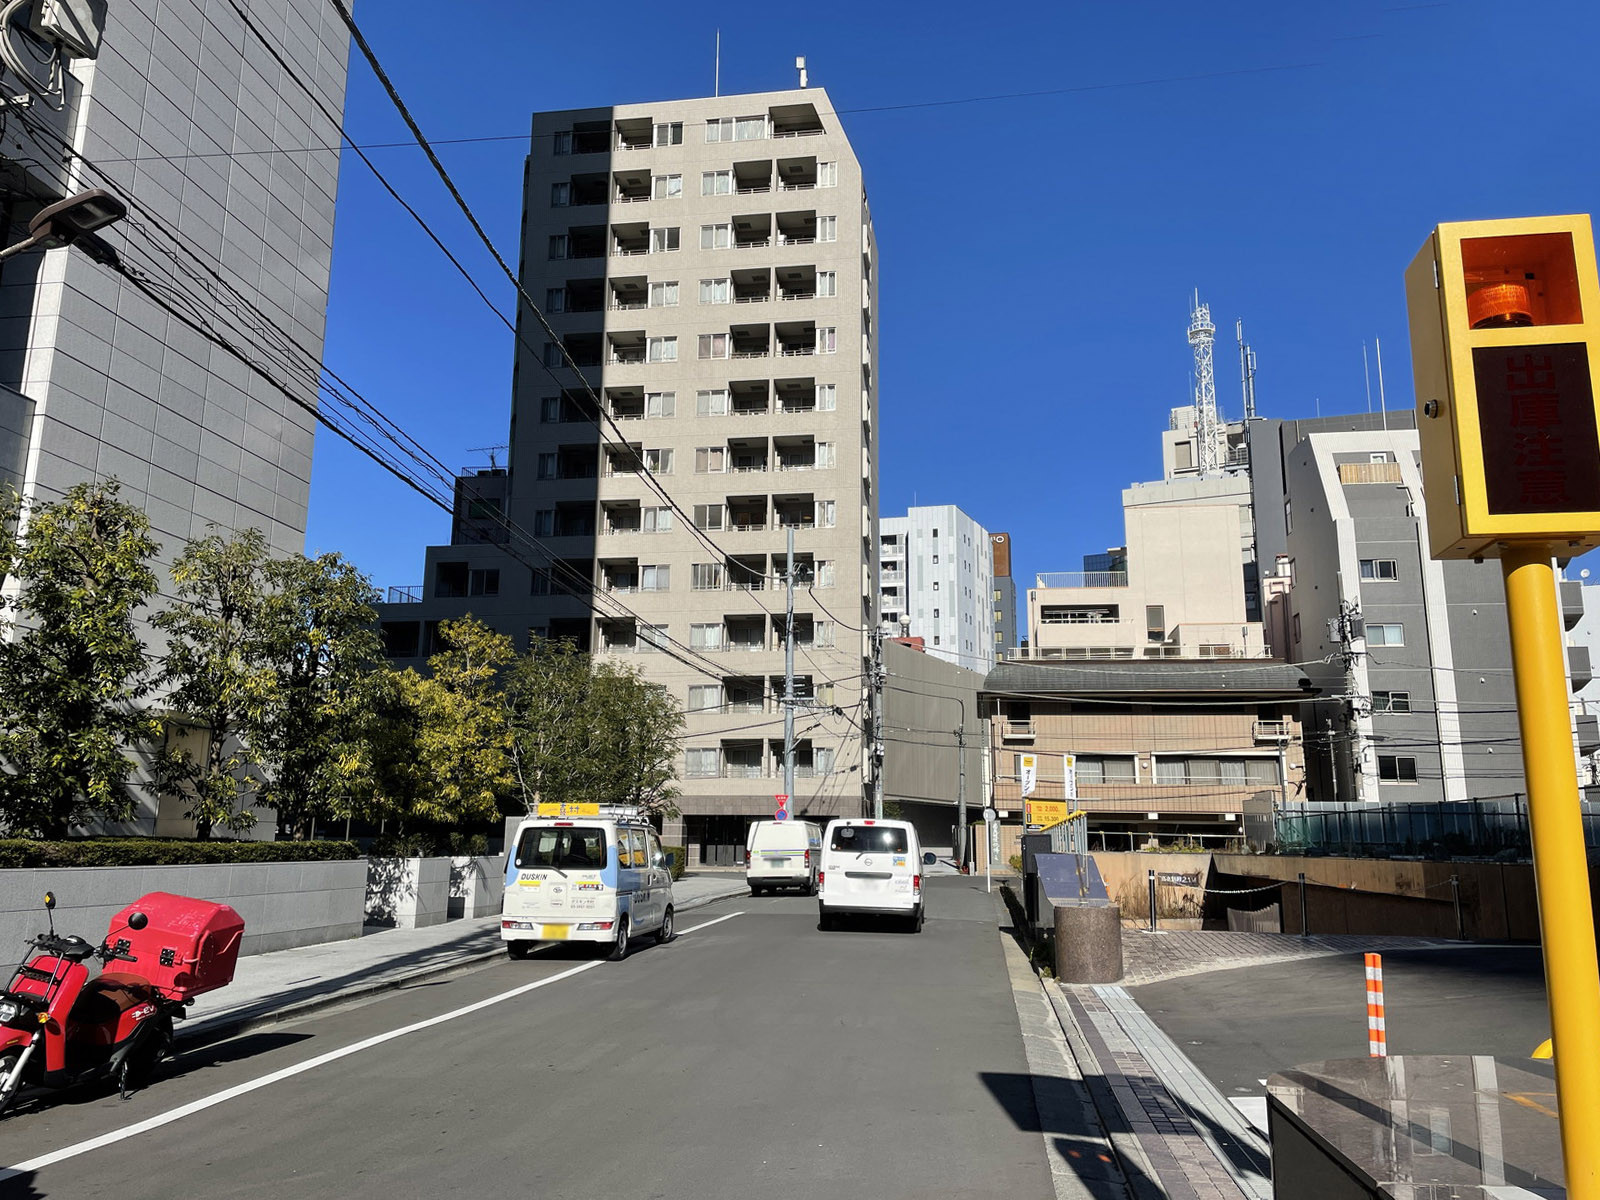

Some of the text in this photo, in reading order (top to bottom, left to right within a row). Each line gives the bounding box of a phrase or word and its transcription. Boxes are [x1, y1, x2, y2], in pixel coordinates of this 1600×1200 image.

[1506, 354, 1571, 504] 出庫注意
[521, 873, 548, 881] DUSKIN
